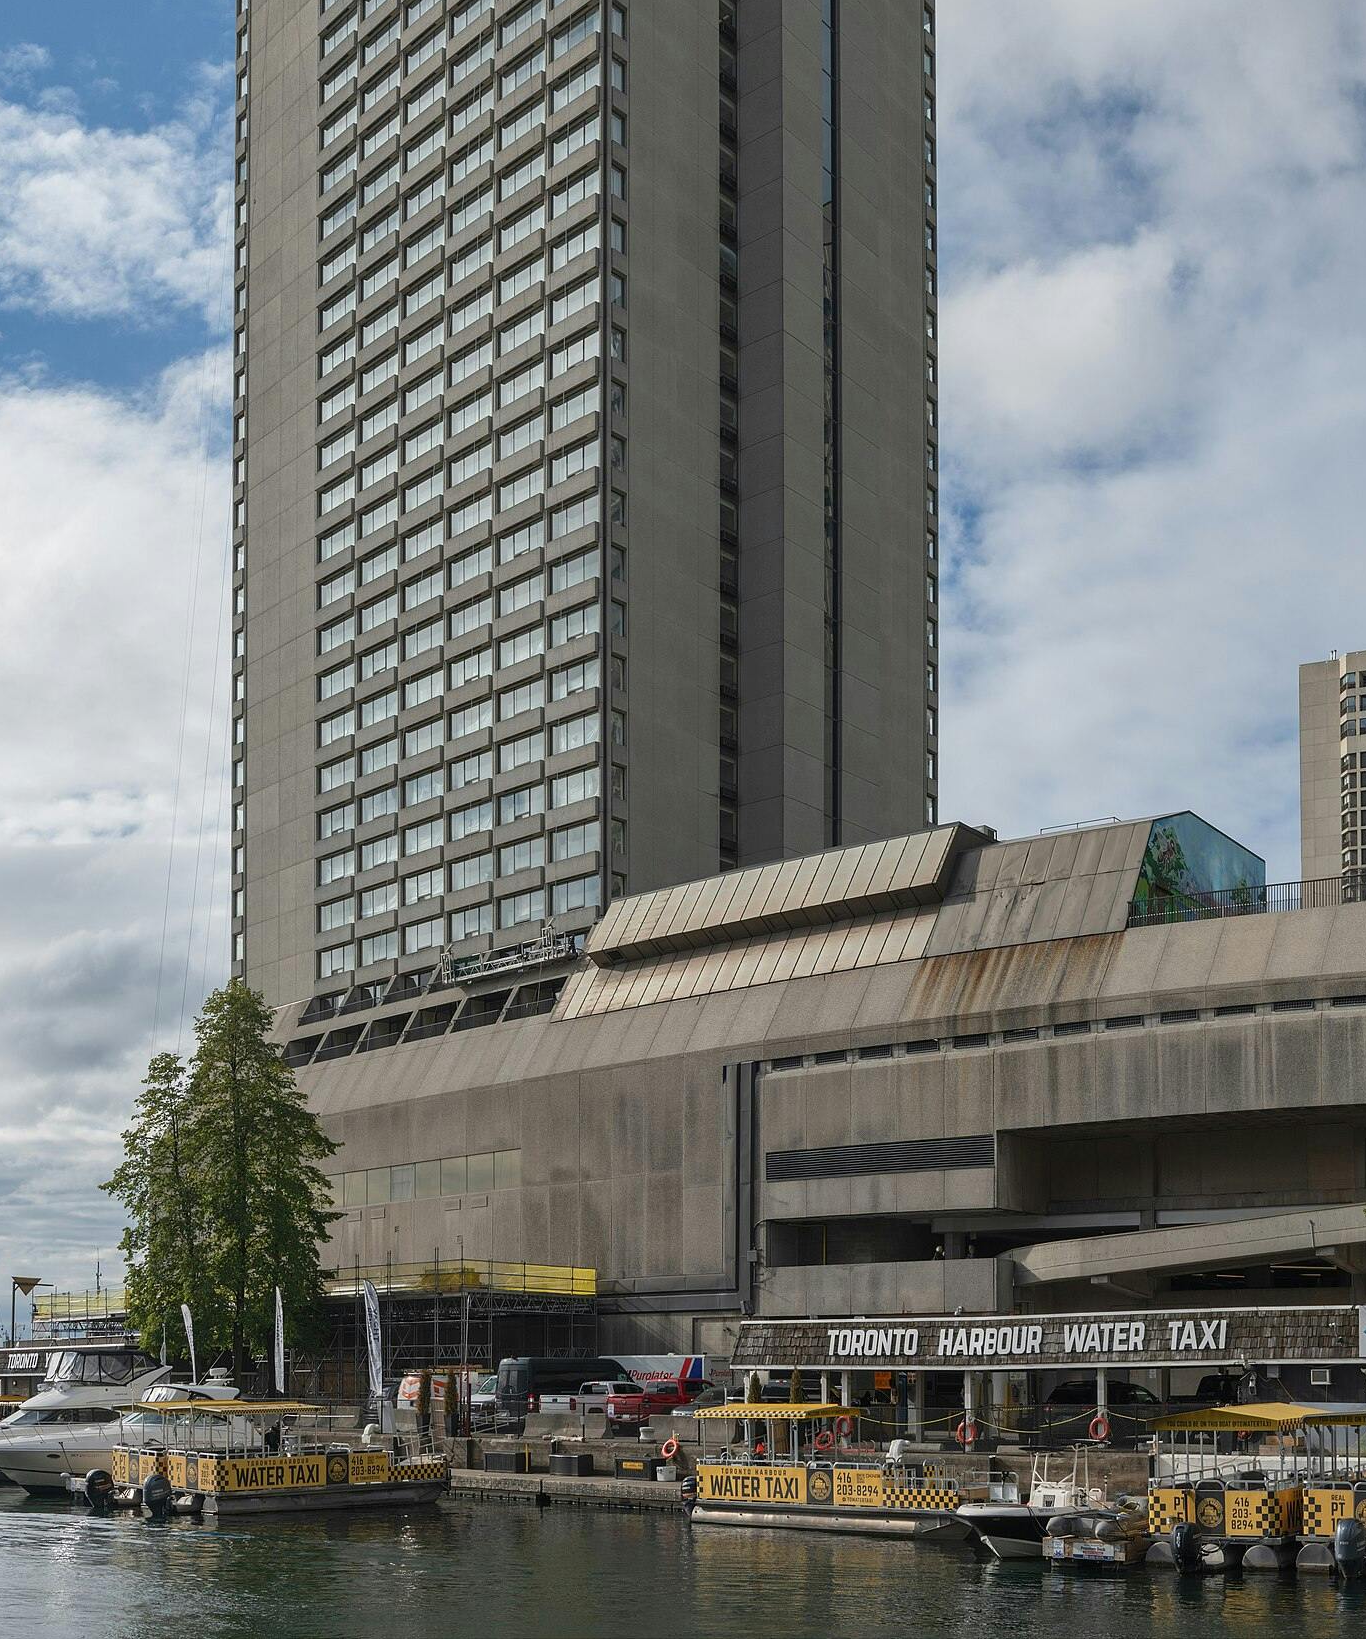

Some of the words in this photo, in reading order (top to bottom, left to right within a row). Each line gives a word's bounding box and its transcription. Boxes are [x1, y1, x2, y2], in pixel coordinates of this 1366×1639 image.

[827, 1328, 919, 1356] TORONTO
[938, 1325, 1043, 1356] HARBOUR
[1063, 1322, 1146, 1353] WATER
[1168, 1319, 1228, 1350] TAXI
[8, 1352, 39, 1369] TORONTO
[631, 1369, 674, 1380] Purolator
[351, 1455, 364, 1465] 416
[236, 1465, 284, 1487] WATER
[288, 1464, 320, 1484] TAXI
[351, 1465, 385, 1475] 203-8294
[837, 1472, 852, 1483] 416
[710, 1475, 761, 1497] WATER
[764, 1476, 799, 1499] TAXI
[837, 1484, 879, 1497] 203-8294
[1234, 1497, 1249, 1507] 416
[1232, 1508, 1252, 1519] 203-
[1331, 1502, 1346, 1516] PT
[1231, 1520, 1254, 1530] 8294
